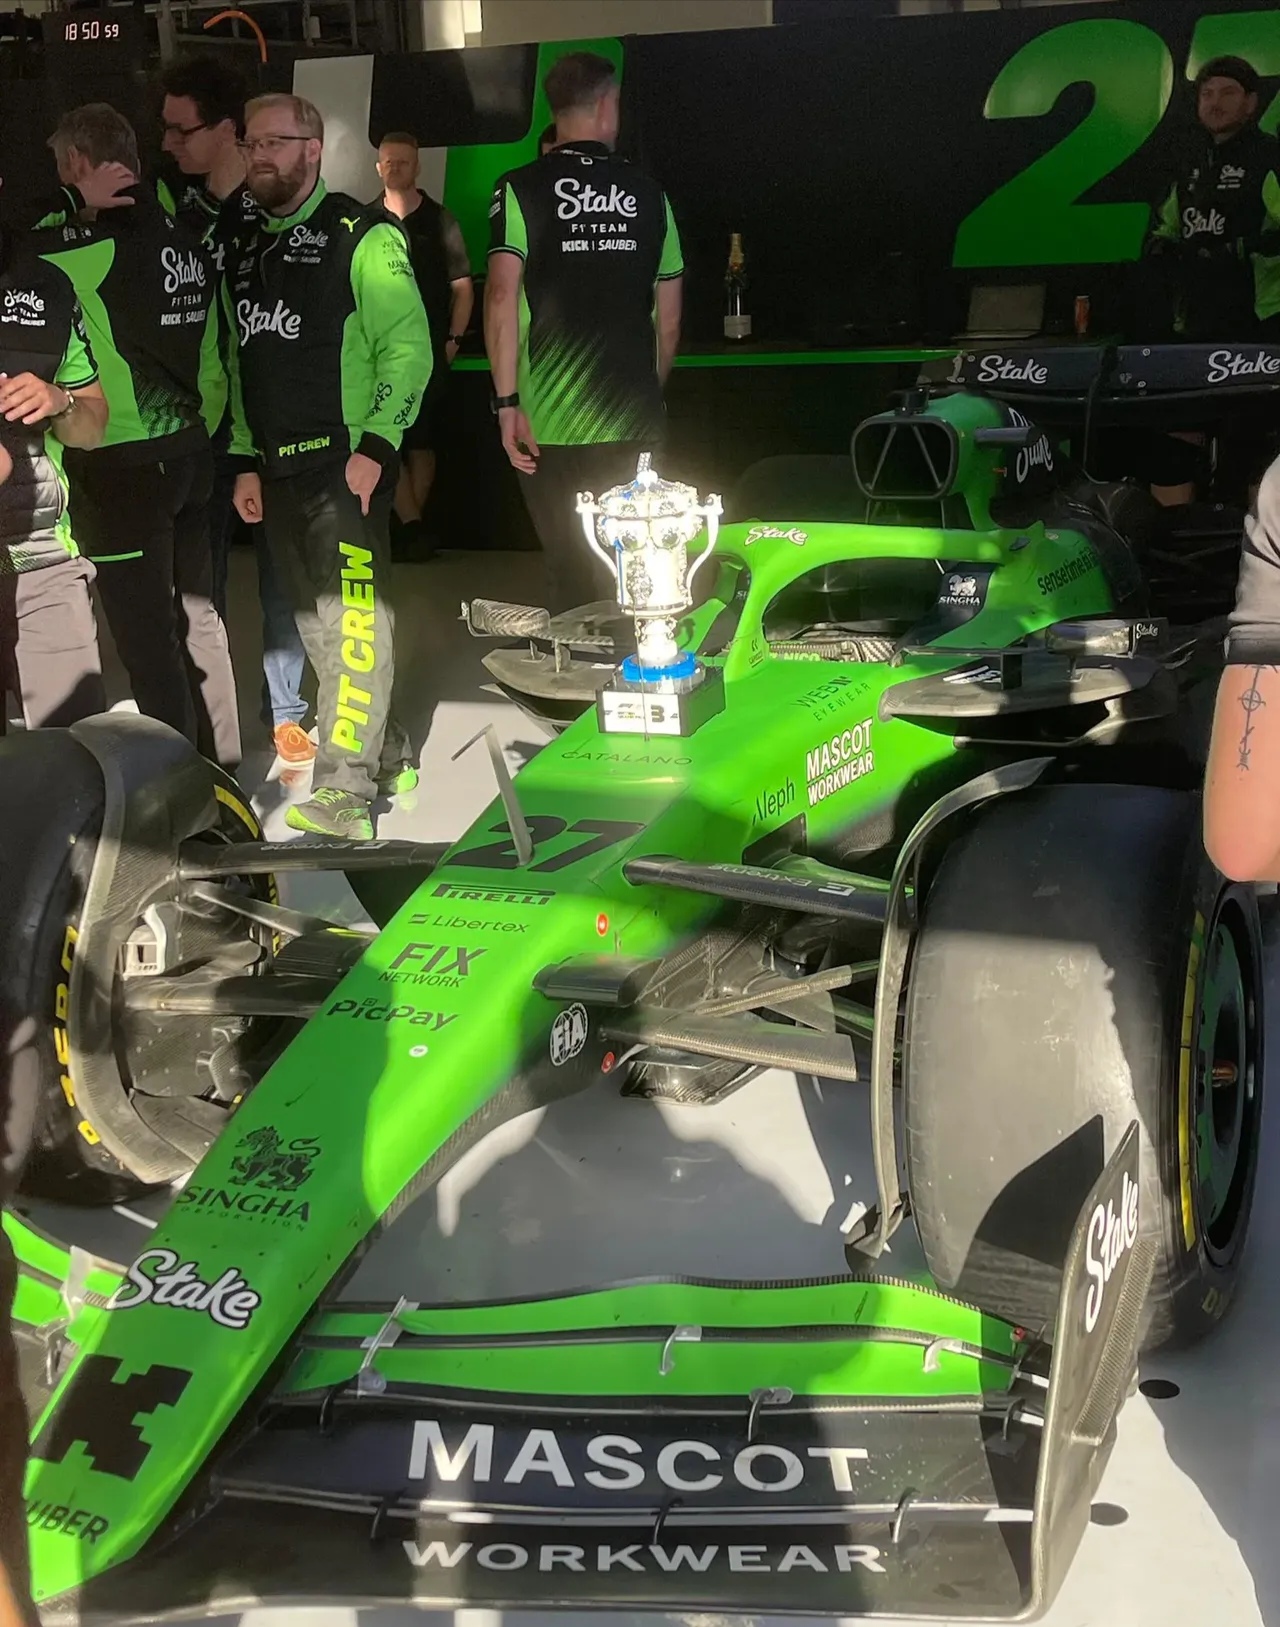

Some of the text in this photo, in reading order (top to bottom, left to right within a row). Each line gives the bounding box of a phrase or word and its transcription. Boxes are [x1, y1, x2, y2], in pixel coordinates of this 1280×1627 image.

[65, 21, 119, 40] 18 50 59
[554, 177, 638, 220] Stake
[288, 225, 329, 247] Stake
[571, 223, 628, 233] F1 TEAM
[1182, 207, 1226, 239] Stake
[561, 239, 638, 252] KICK SAUBER
[161, 246, 206, 293] Stake
[161, 312, 181, 326] KICK
[236, 298, 302, 347] Stake
[977, 354, 1049, 385] Stake
[1207, 350, 1280, 384] Stake
[393, 392, 416, 426] Stake
[278, 436, 331, 457] PIT CREW
[744, 525, 808, 546] Stake
[939, 595, 981, 606] SINGHA
[331, 541, 376, 754] PIT CREW
[1135, 623, 1159, 640] Stake
[650, 704, 666, 723] 3
[813, 682, 871, 722] EYEWEAR
[561, 751, 693, 765] CATALANO
[806, 716, 874, 784] MASCOT
[806, 750, 875, 808] WORKWEAR
[443, 815, 648, 873] 27
[431, 883, 557, 905] PIRELLI
[432, 915, 530, 933] Libertex
[388, 942, 488, 976] FIX
[378, 970, 466, 988] NETWORK
[326, 998, 461, 1032] PicPay
[176, 1185, 310, 1223] SINGHA
[1085, 1171, 1139, 1334] Stake
[106, 1247, 262, 1330] Stake
[407, 1418, 869, 1493] MASCOT
[402, 1539, 888, 1574] WORKWEAR
